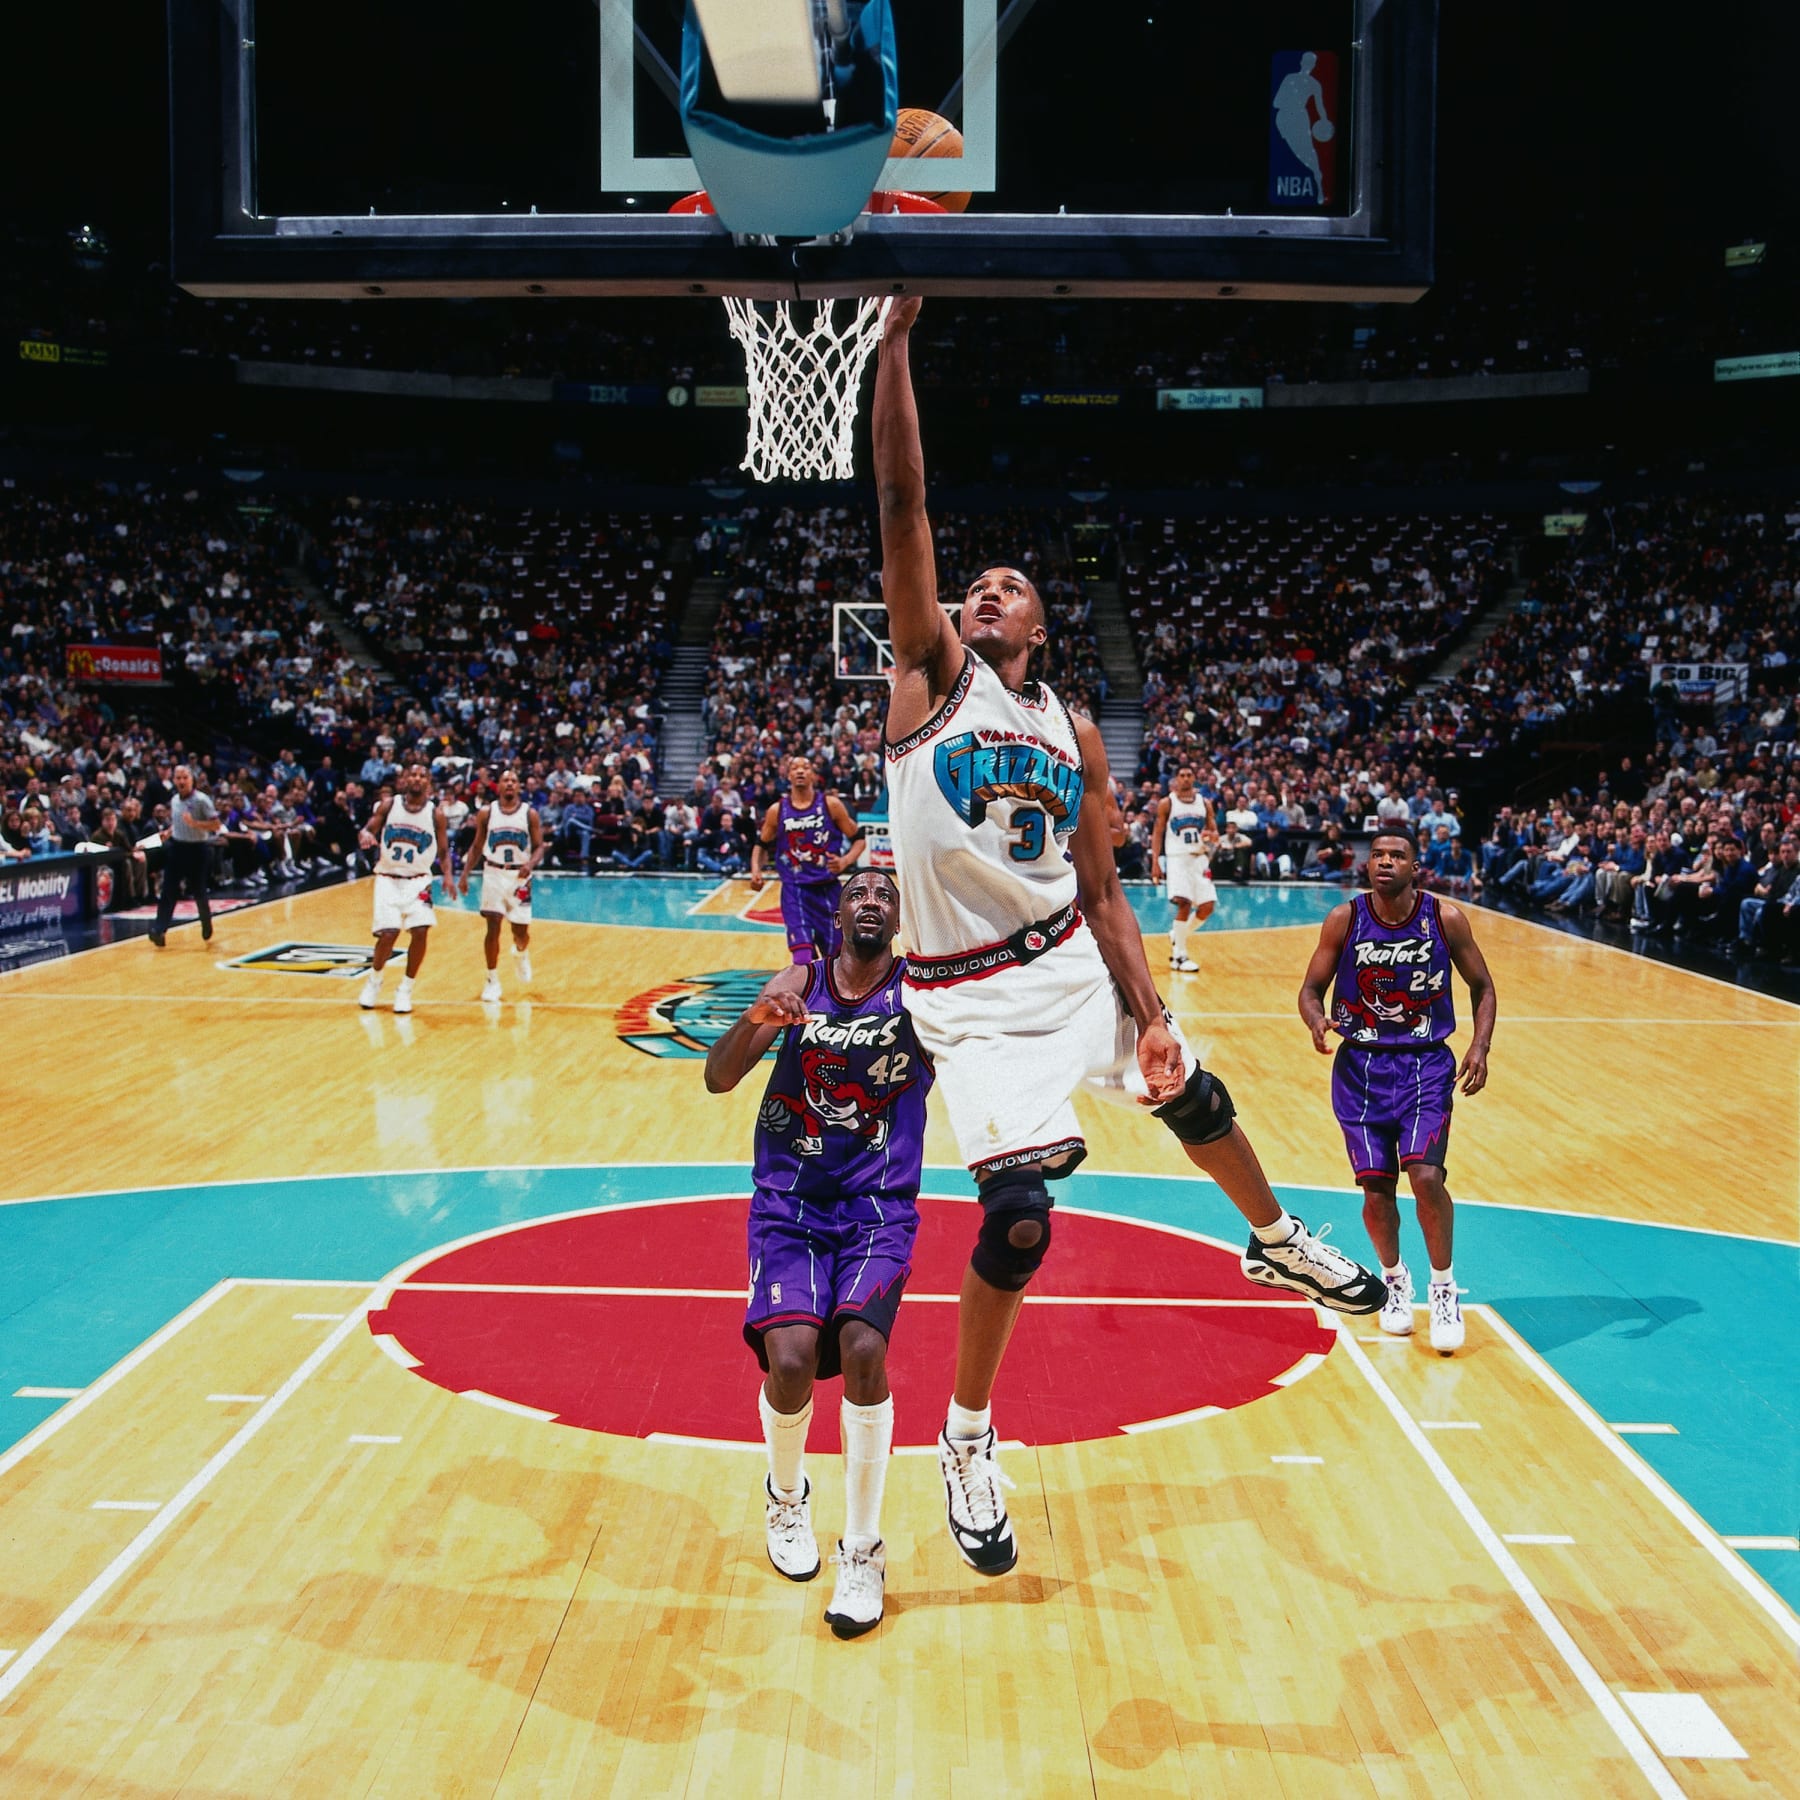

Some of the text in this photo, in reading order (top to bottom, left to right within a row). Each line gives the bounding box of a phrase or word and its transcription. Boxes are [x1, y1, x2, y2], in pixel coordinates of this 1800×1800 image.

[1277, 176, 1314, 197] NBA
[588, 384, 629, 405] IBM
[812, 830, 830, 845] 34
[1009, 806, 1047, 862] 3
[392, 846, 414, 864] 34
[17, 872, 71, 901] Mobility
[1410, 969, 1445, 991] 24
[867, 1052, 911, 1086] 42
